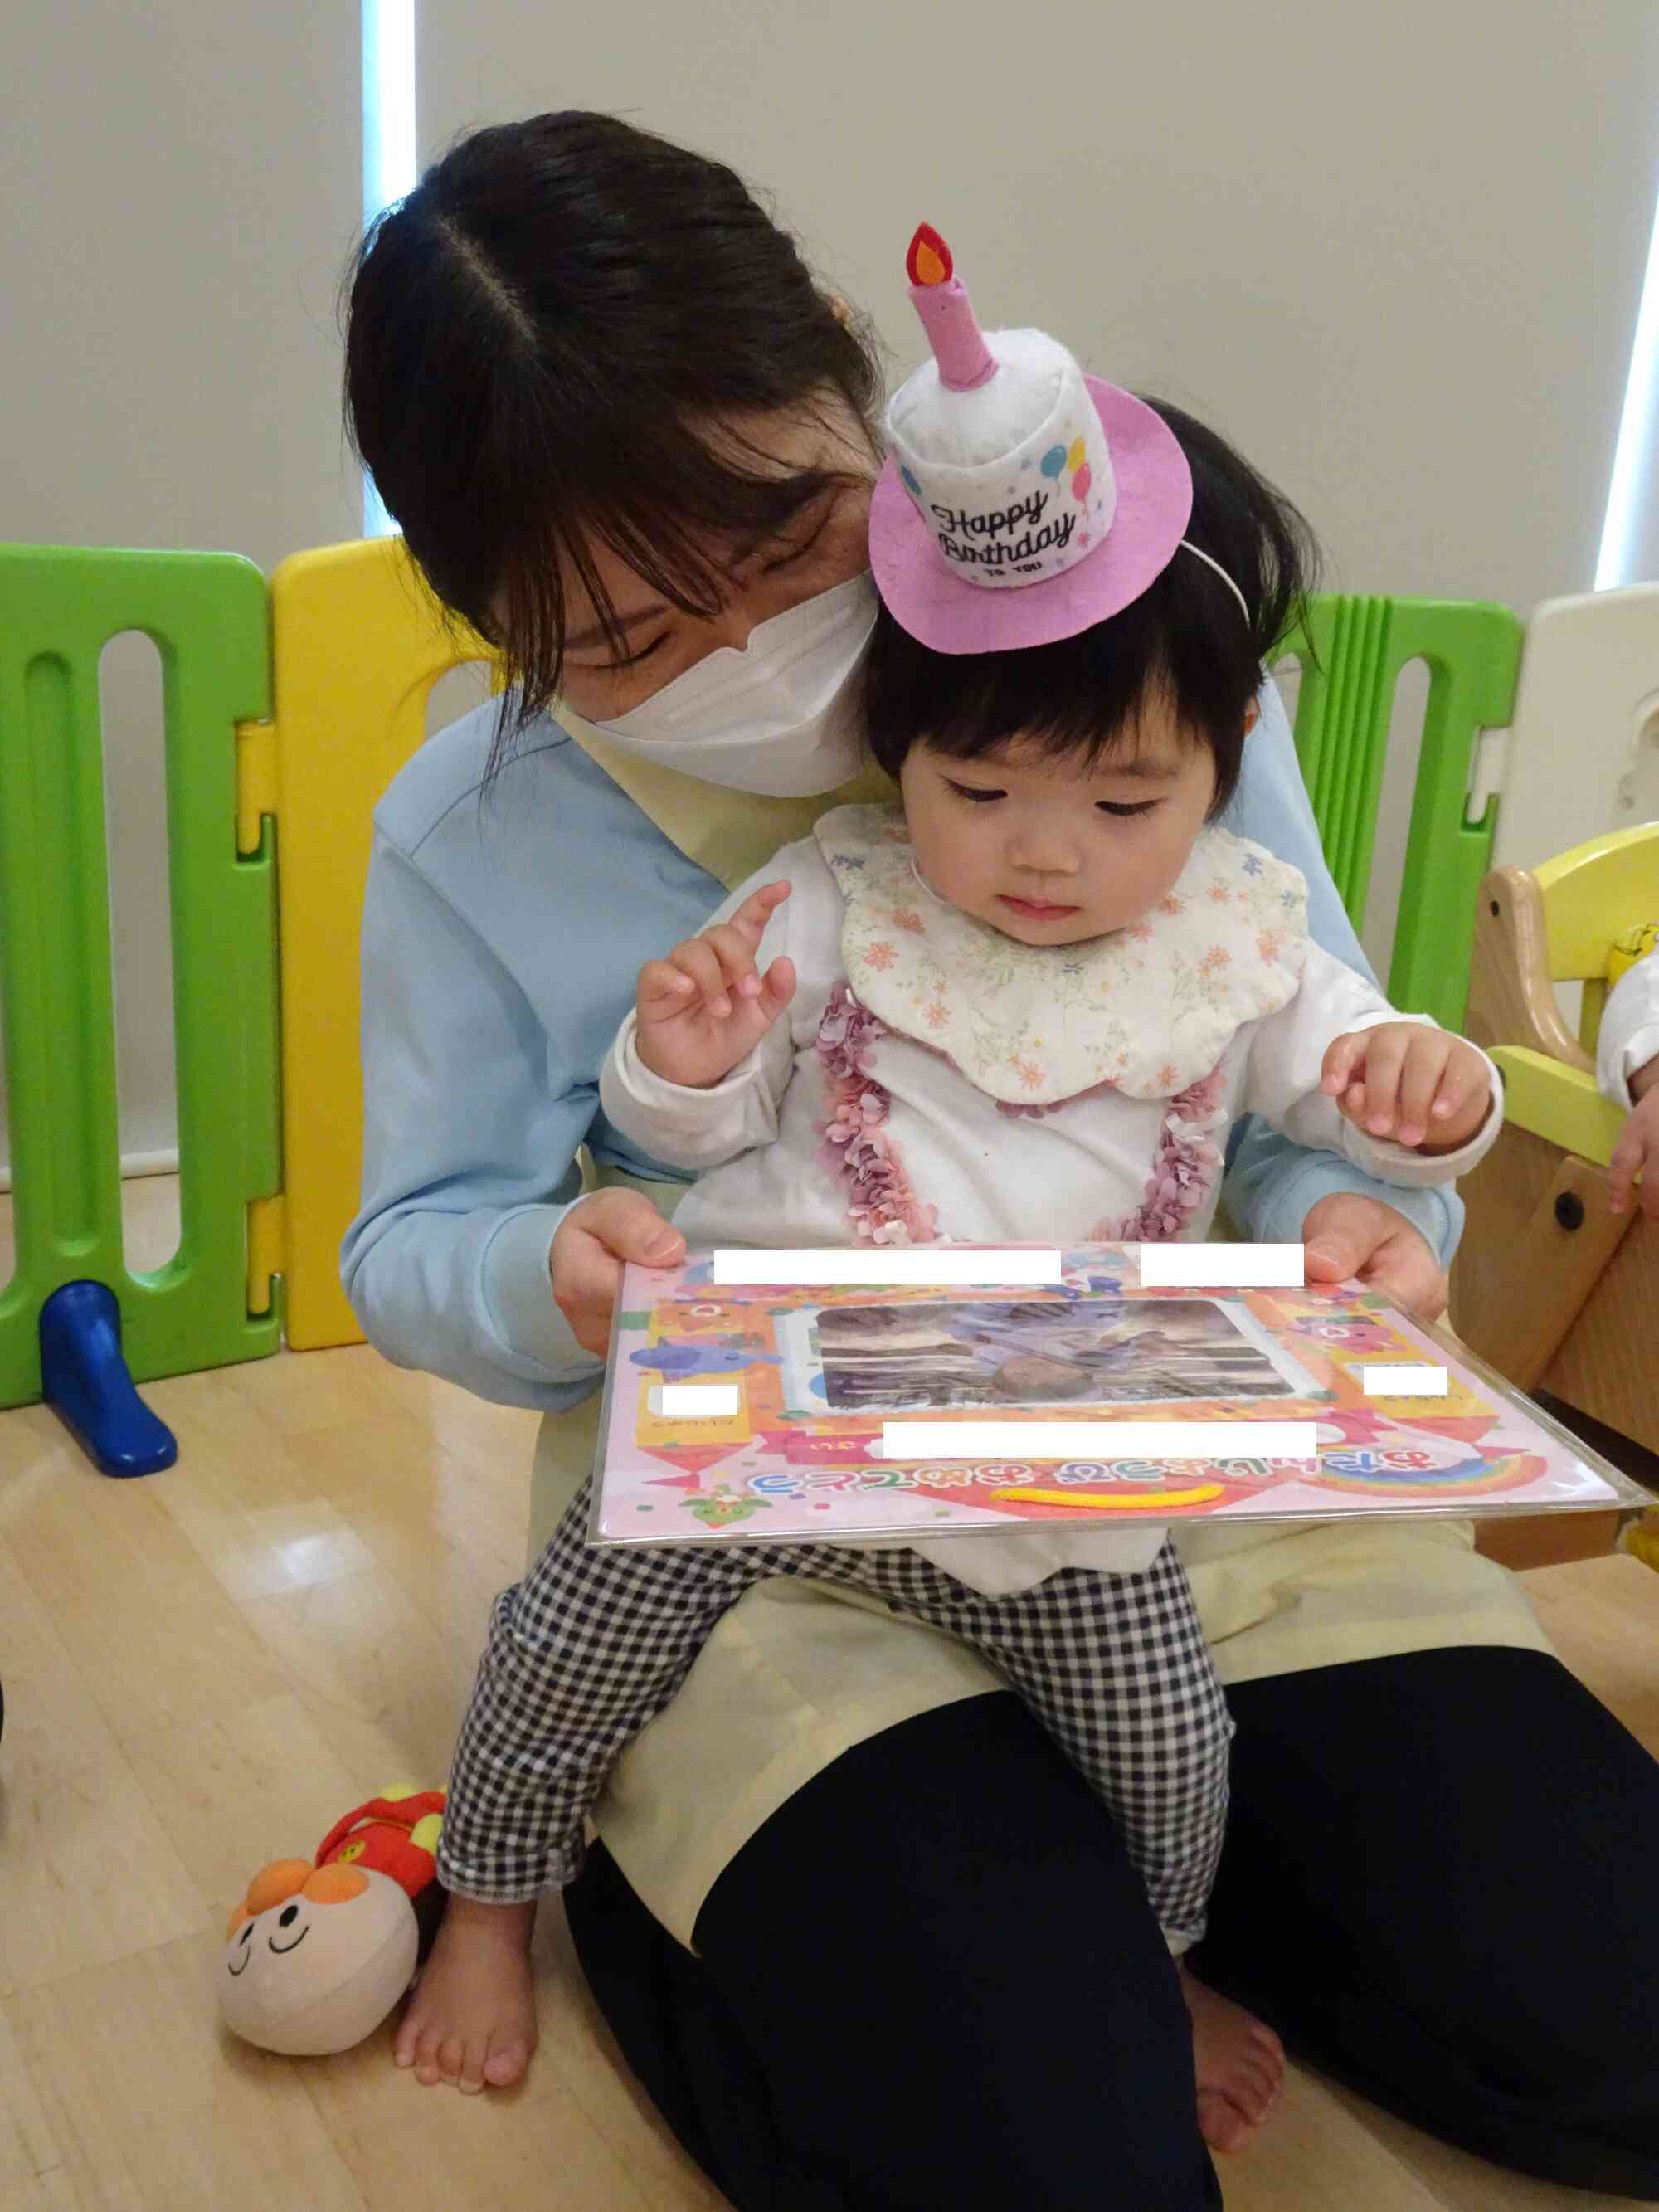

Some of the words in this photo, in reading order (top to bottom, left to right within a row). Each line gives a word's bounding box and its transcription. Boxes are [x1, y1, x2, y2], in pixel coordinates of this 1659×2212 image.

[930, 490, 1048, 540] Happy
[938, 512, 1076, 564] Birthday
[748, 1464, 1034, 1493] おめでとう
